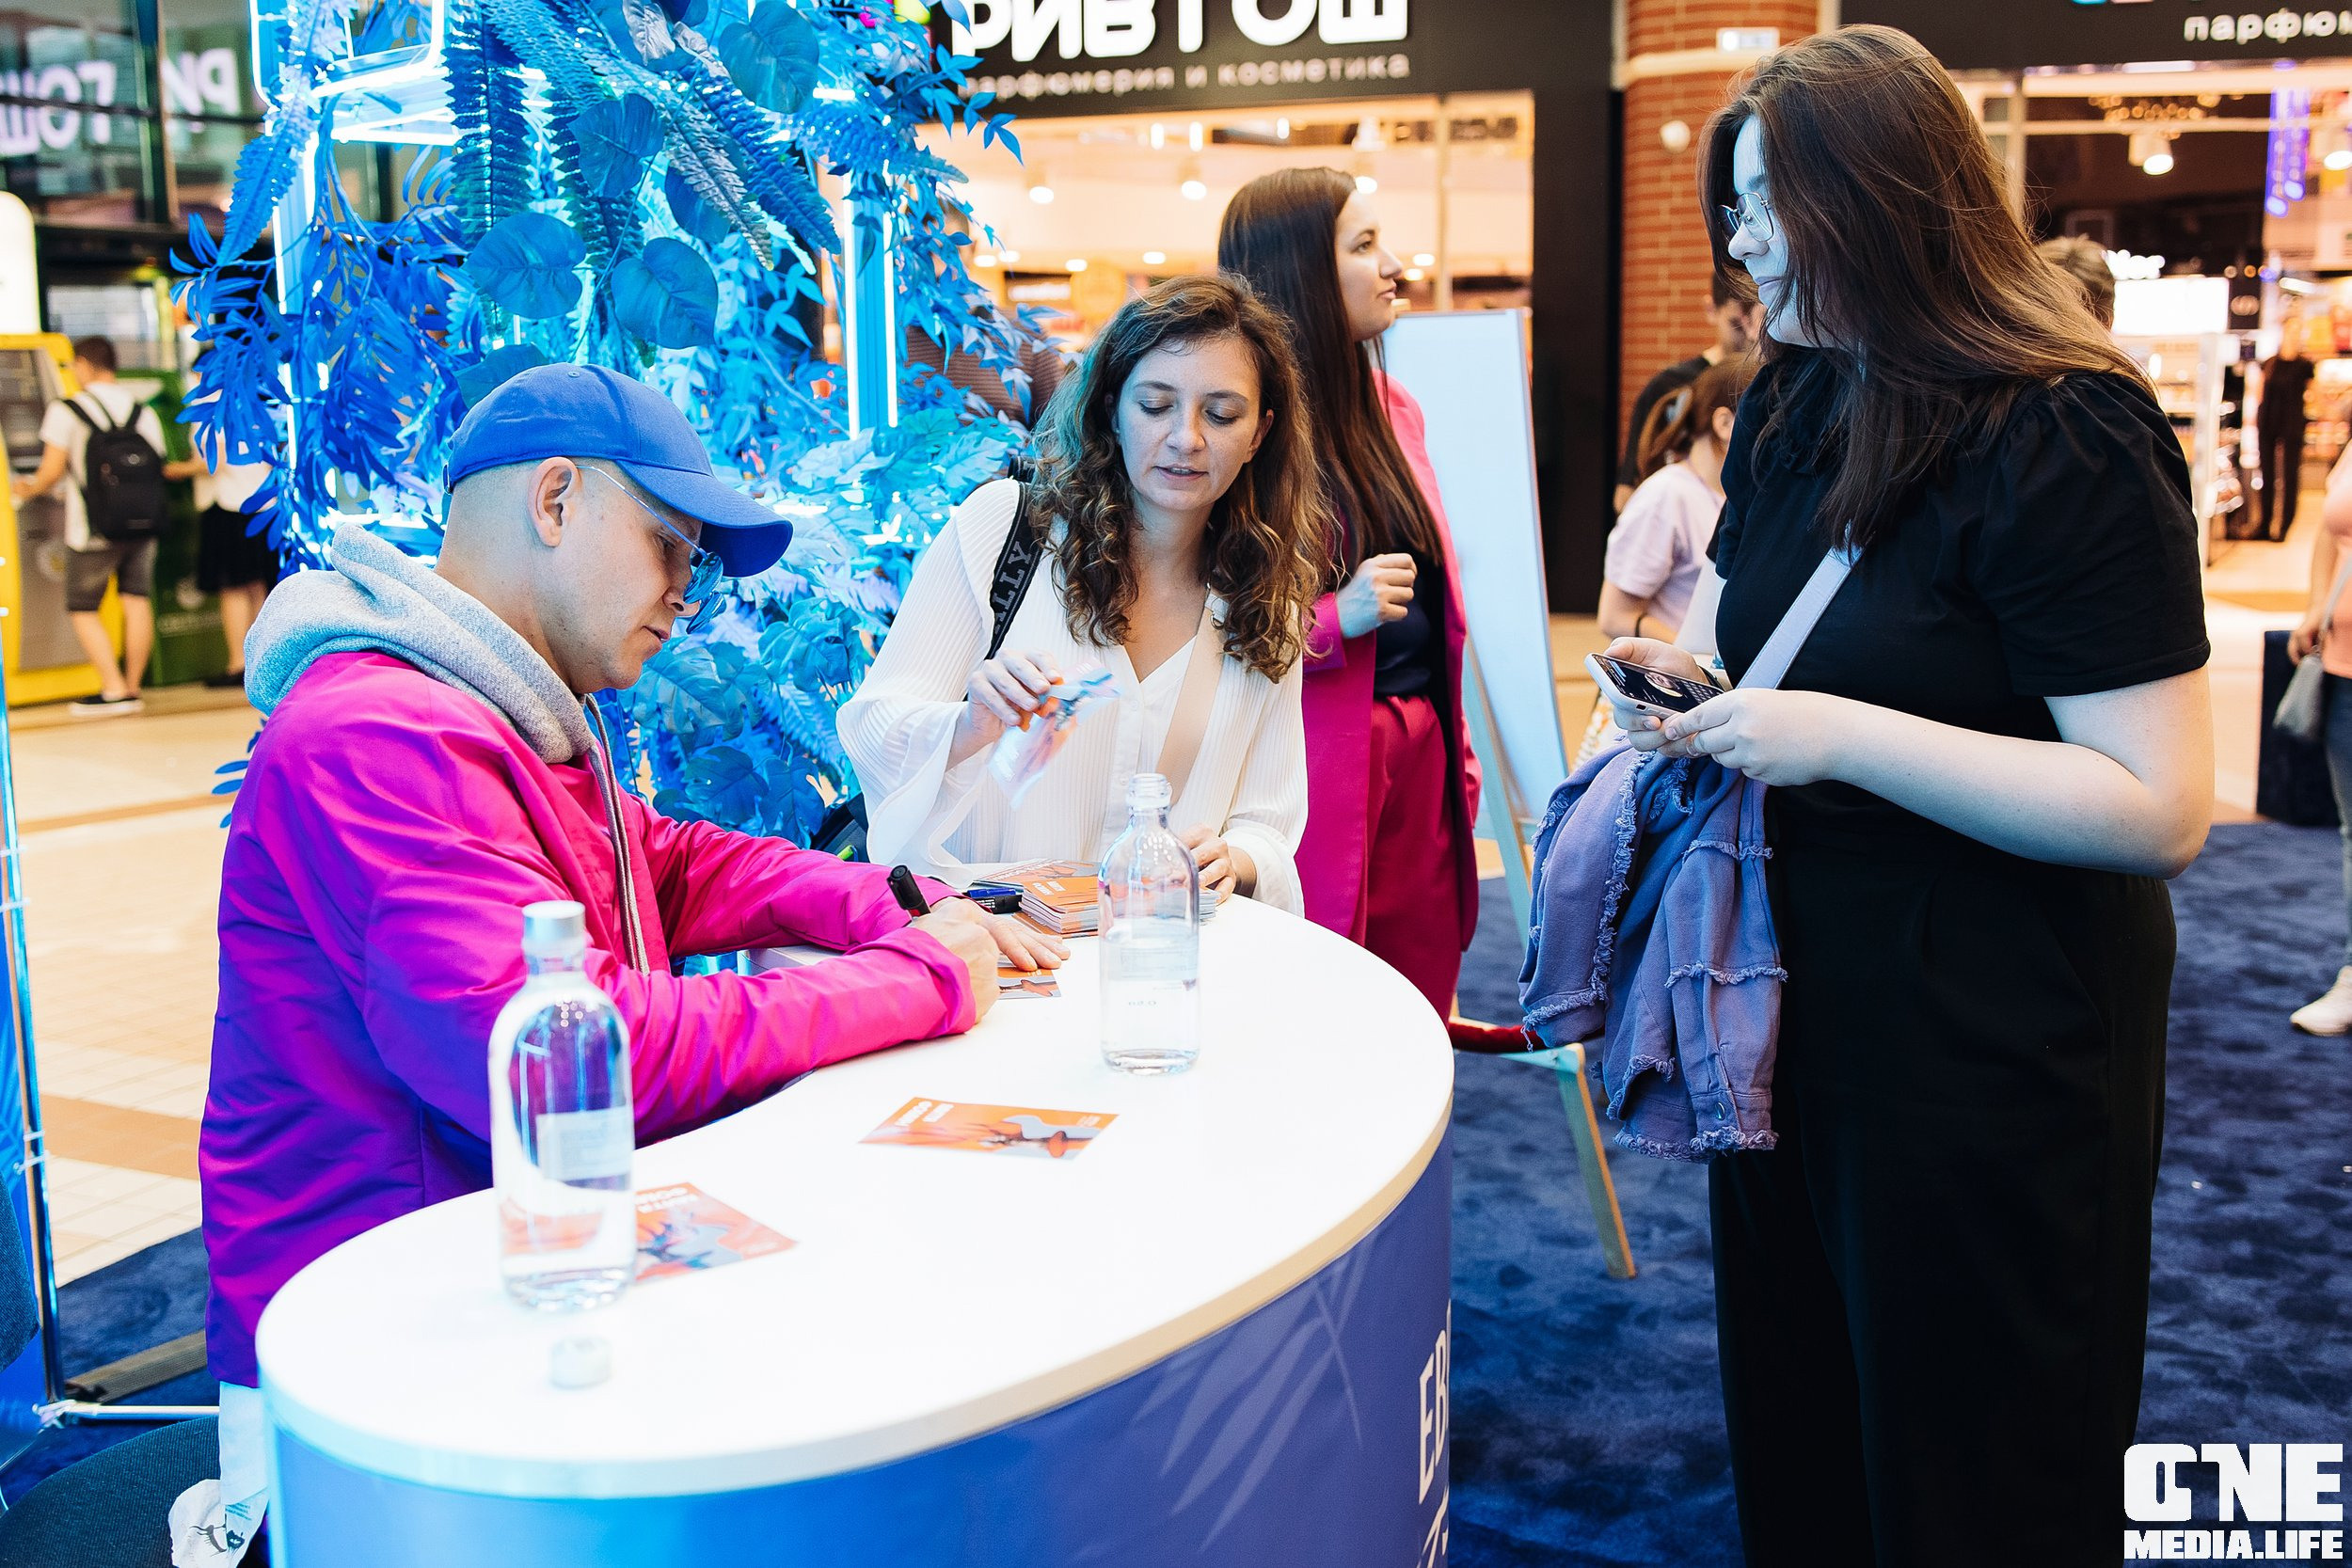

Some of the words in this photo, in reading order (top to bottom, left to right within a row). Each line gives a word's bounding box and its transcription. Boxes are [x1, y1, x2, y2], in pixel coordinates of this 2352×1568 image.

[1184, 65, 1208, 88] и
[1217, 54, 1410, 87] косметика
[991, 540, 1032, 635] LLY
